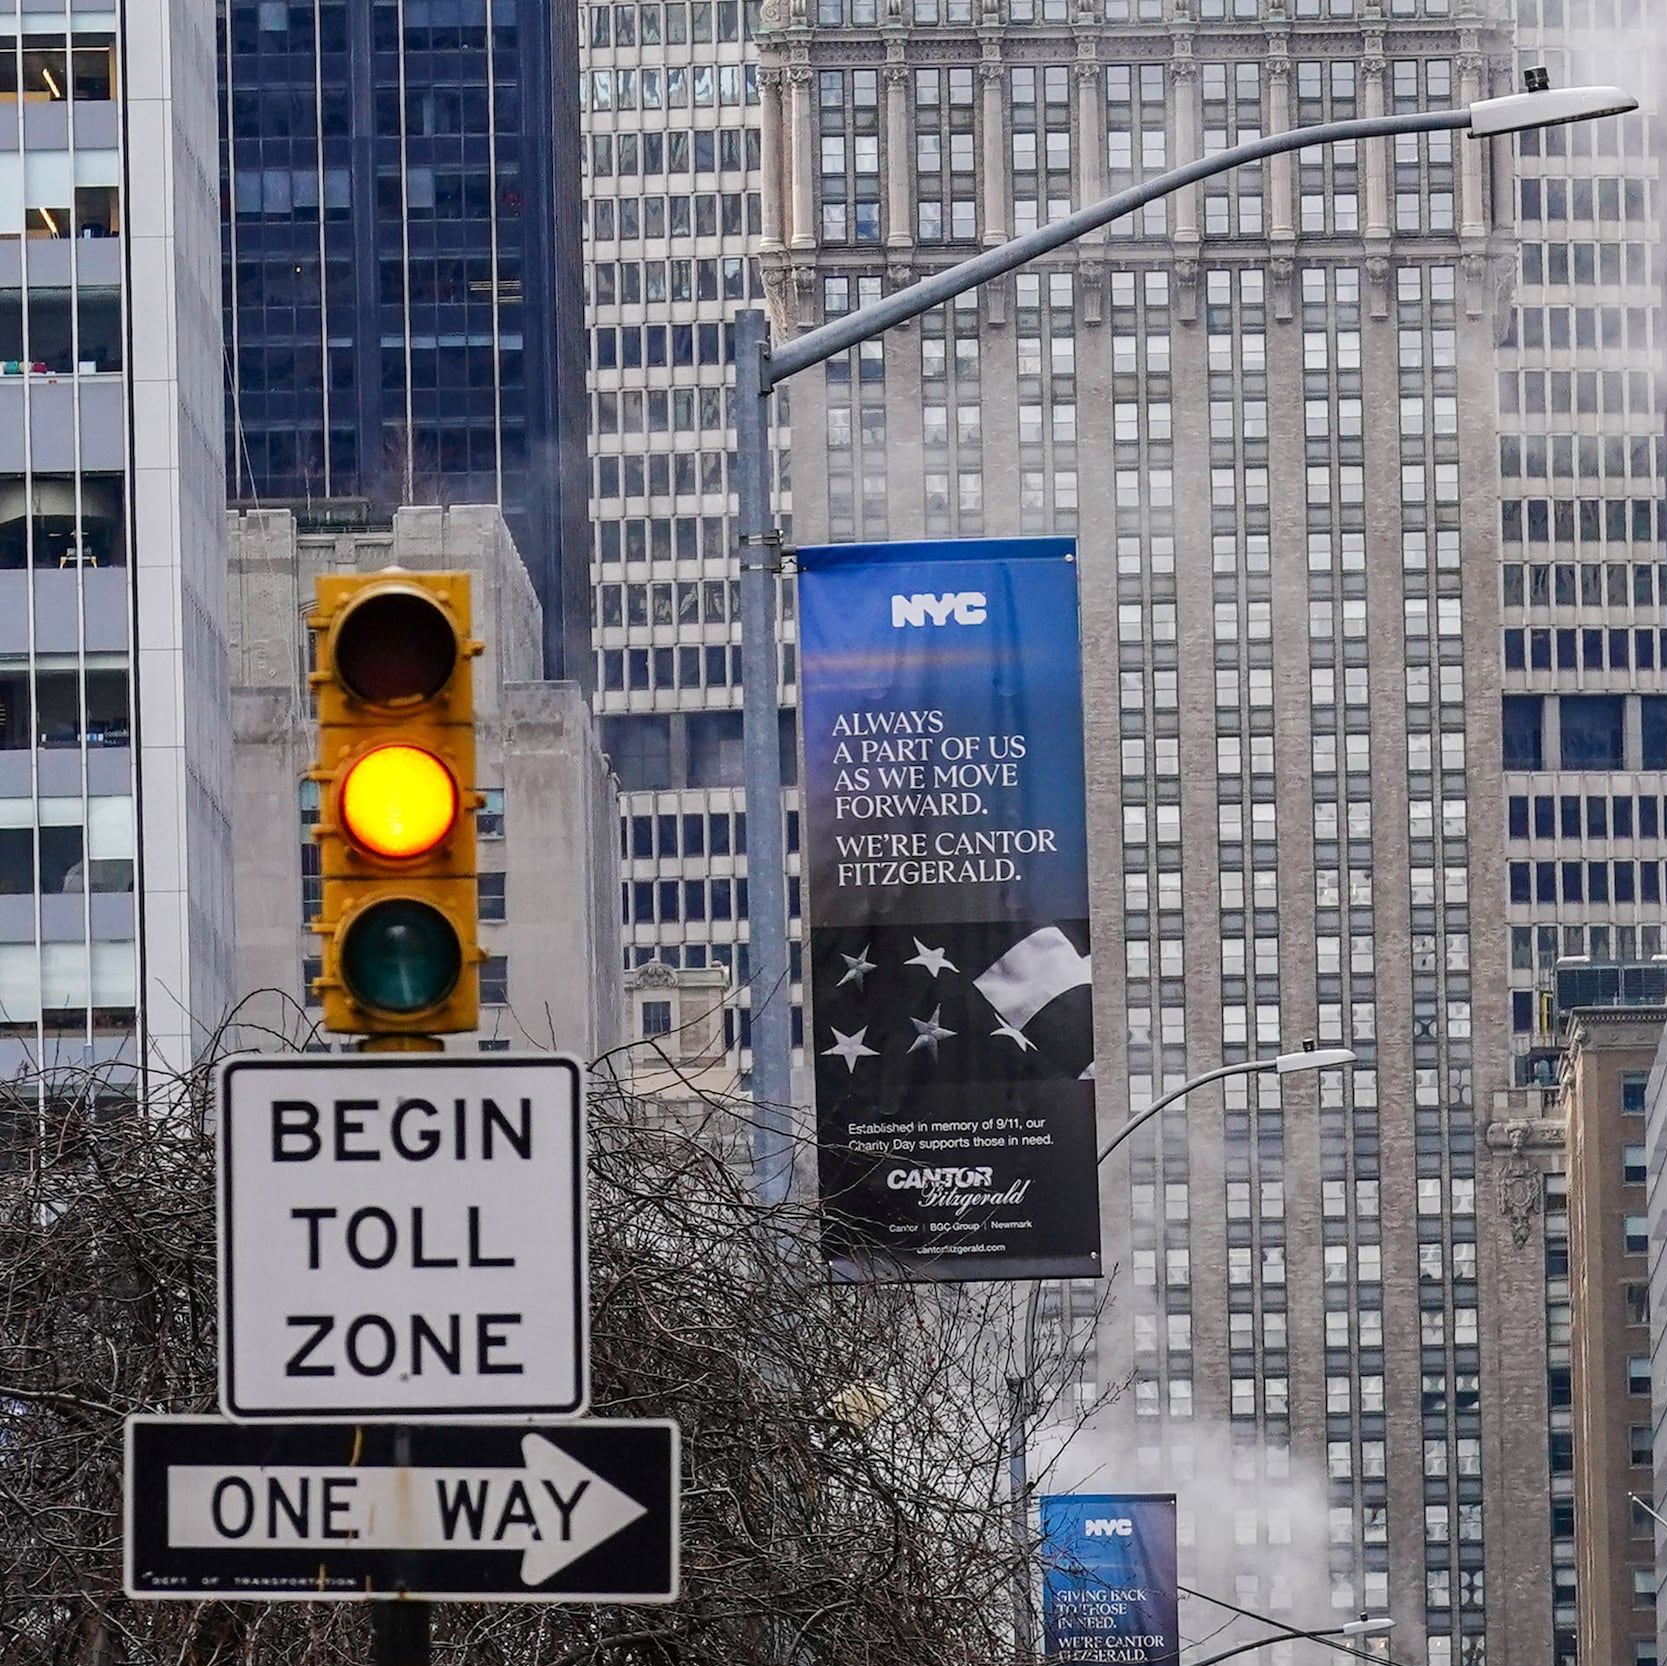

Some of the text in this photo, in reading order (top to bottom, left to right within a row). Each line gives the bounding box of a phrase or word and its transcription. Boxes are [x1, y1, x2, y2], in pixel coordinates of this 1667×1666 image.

[892, 592, 987, 627] NYC
[832, 710, 944, 736] ALWAYS
[833, 735, 1026, 764] A PART OF US
[834, 763, 1019, 791] AS WE MOVE
[835, 793, 988, 819] FORWARD.
[835, 829, 1058, 858] WE'RE CANTOR
[837, 859, 1022, 887] FITZGERALD.
[270, 1097, 533, 1162] BEGIN
[849, 1118, 1047, 1135] Established in memory of 9/11, our
[849, 1134, 1054, 1152] Charity Day supports those in need.
[886, 1166, 993, 1190] CANTOR
[917, 1178, 1031, 1217] Fitzgerald
[291, 1206, 515, 1270] TOLL
[889, 1223, 918, 1233] Cantor
[953, 1221, 980, 1234] Group
[991, 1220, 1032, 1230] Newmark
[284, 1312, 525, 1378] ZONE
[211, 1476, 590, 1542] ONE WAY
[1085, 1519, 1132, 1537] NYC
[1056, 1589, 1148, 1602] GIVING BACK
[1057, 1635, 1164, 1649] WE'RE CANTOR
